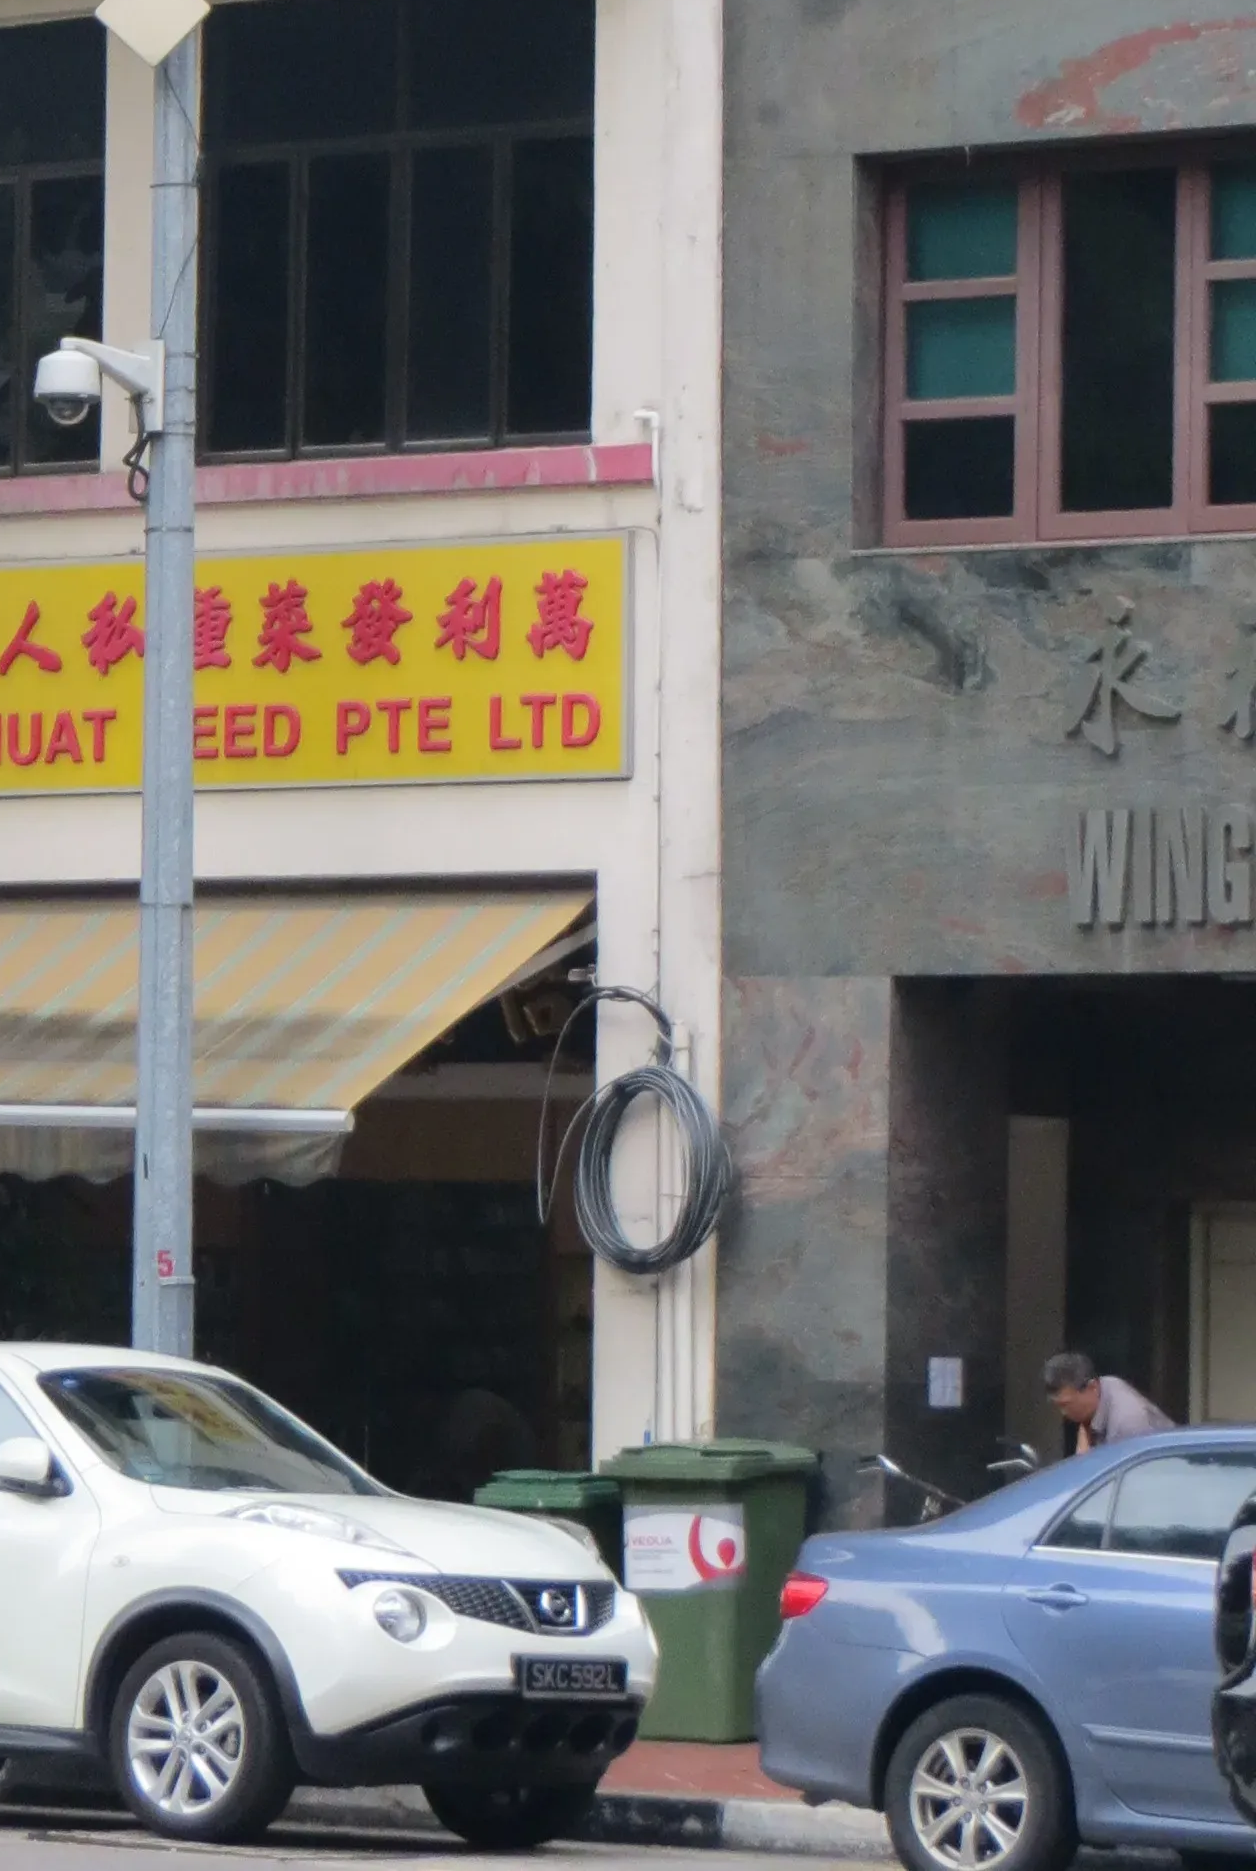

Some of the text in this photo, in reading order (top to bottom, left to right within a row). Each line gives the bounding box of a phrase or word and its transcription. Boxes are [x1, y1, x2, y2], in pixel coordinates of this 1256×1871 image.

[193, 702, 304, 761] EED
[335, 695, 454, 756] PTE
[488, 690, 604, 753] LTD
[1068, 803, 1255, 926] WING
[157, 1249, 173, 1277] 5
